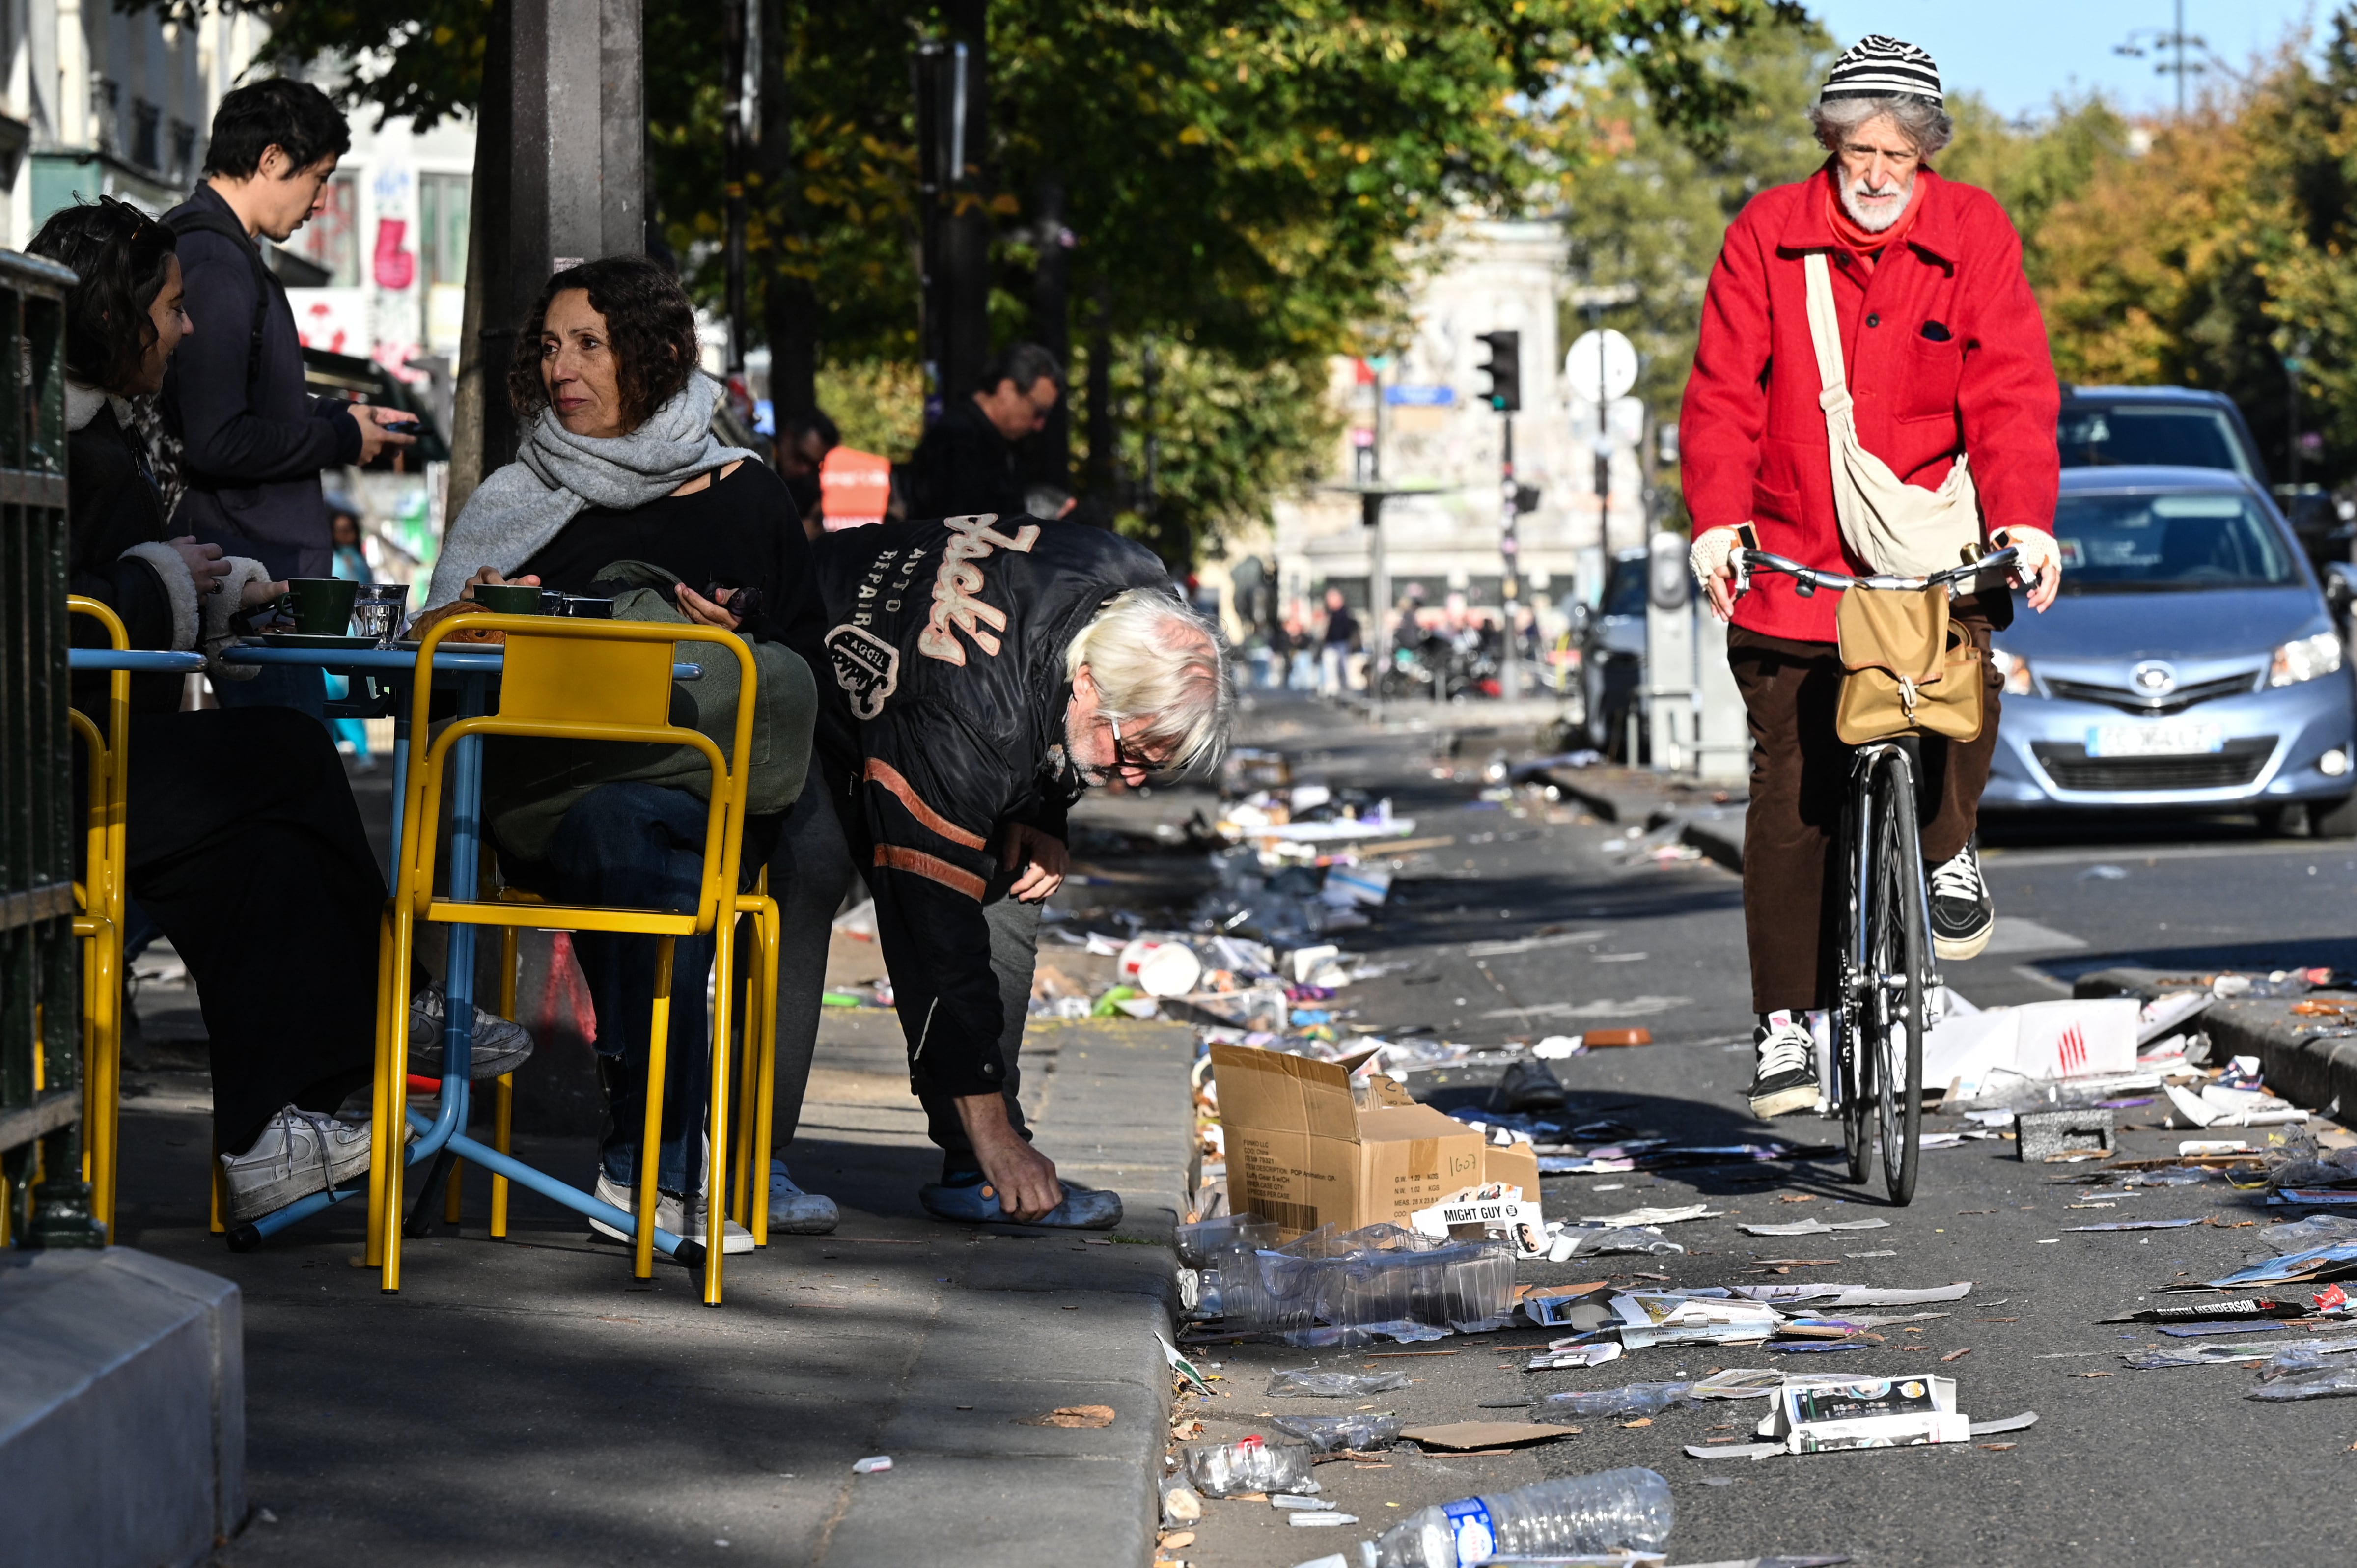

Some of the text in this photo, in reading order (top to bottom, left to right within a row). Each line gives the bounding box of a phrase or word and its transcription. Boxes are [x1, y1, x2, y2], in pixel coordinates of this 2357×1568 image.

[853, 550, 898, 626] REPAIR
[885, 548, 927, 612] AUTO
[1444, 1206, 1500, 1222] MIGHT GUY
[2156, 1299, 2256, 1316] DUSTIN HENDERSON
